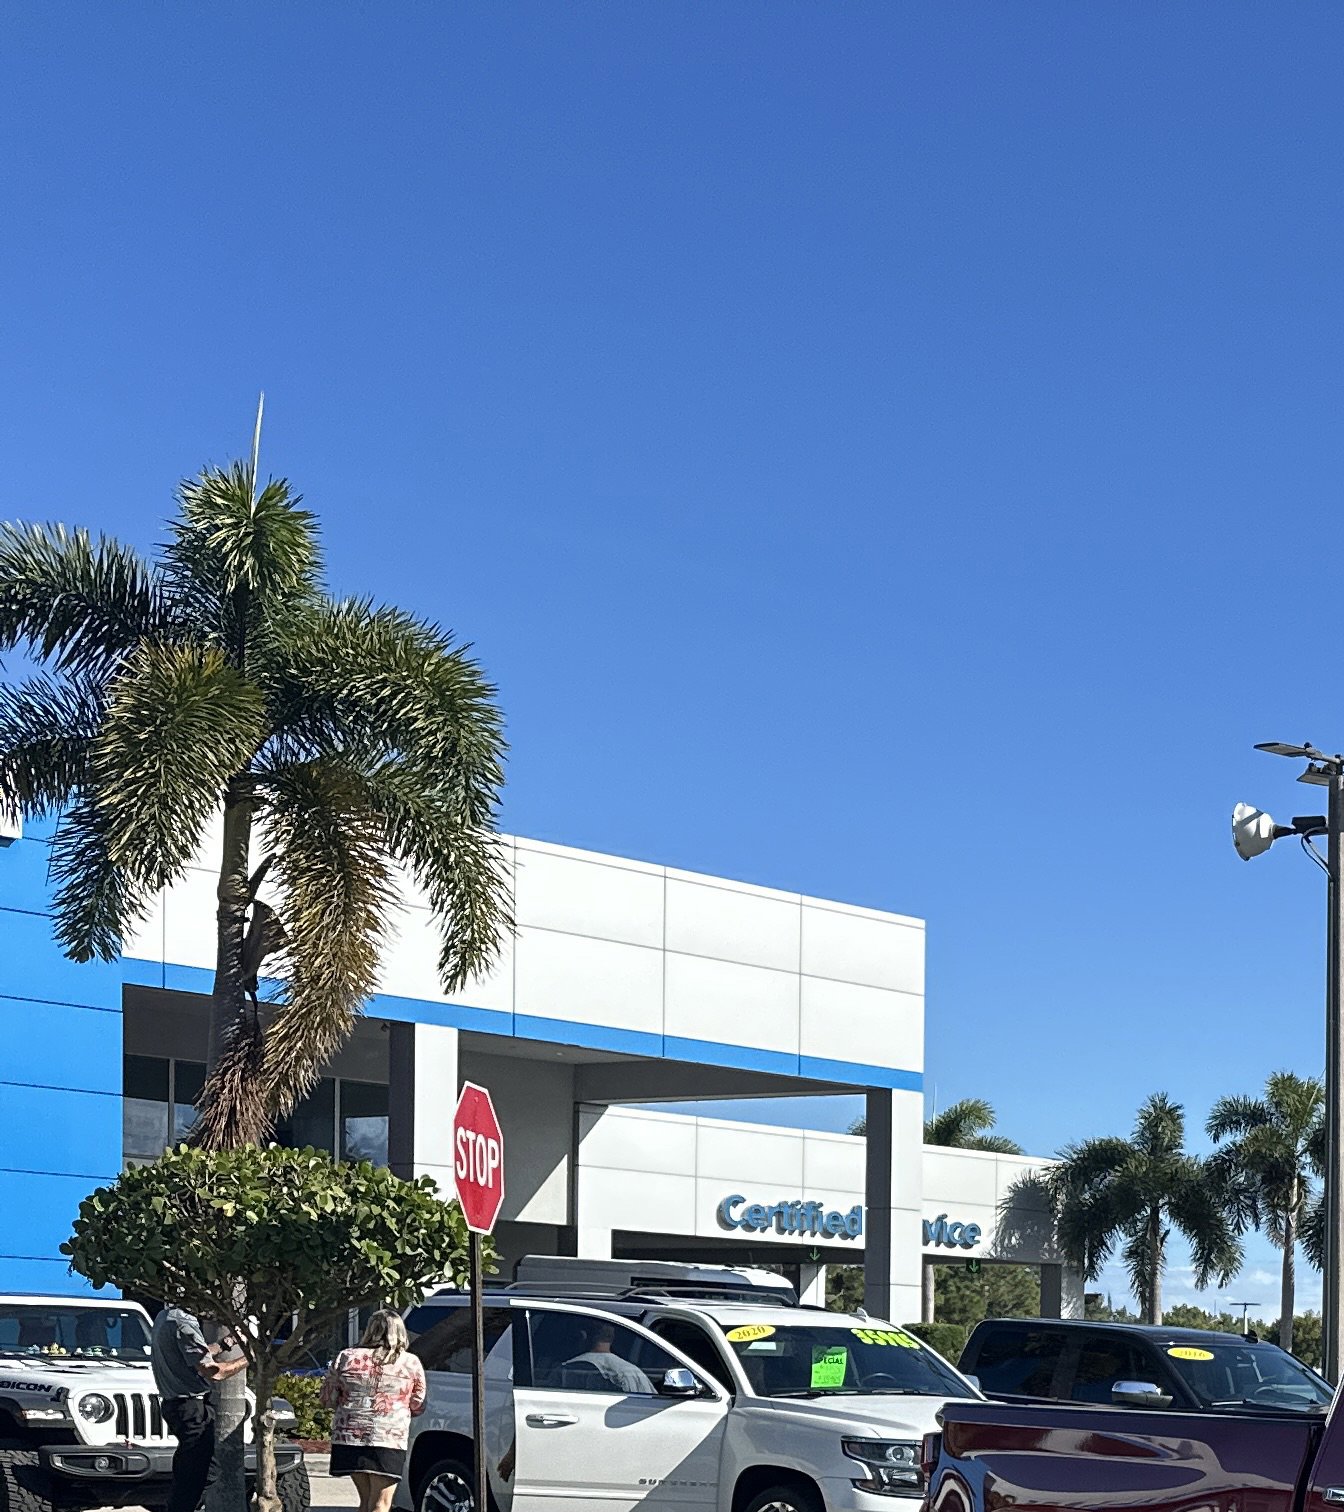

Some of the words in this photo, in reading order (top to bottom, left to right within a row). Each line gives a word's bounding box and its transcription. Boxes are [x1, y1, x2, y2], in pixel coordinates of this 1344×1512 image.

[456, 1126, 500, 1189] STOP
[717, 1194, 862, 1239] Certified
[922, 1213, 982, 1249] vice
[0, 1380, 53, 1392] BICON
